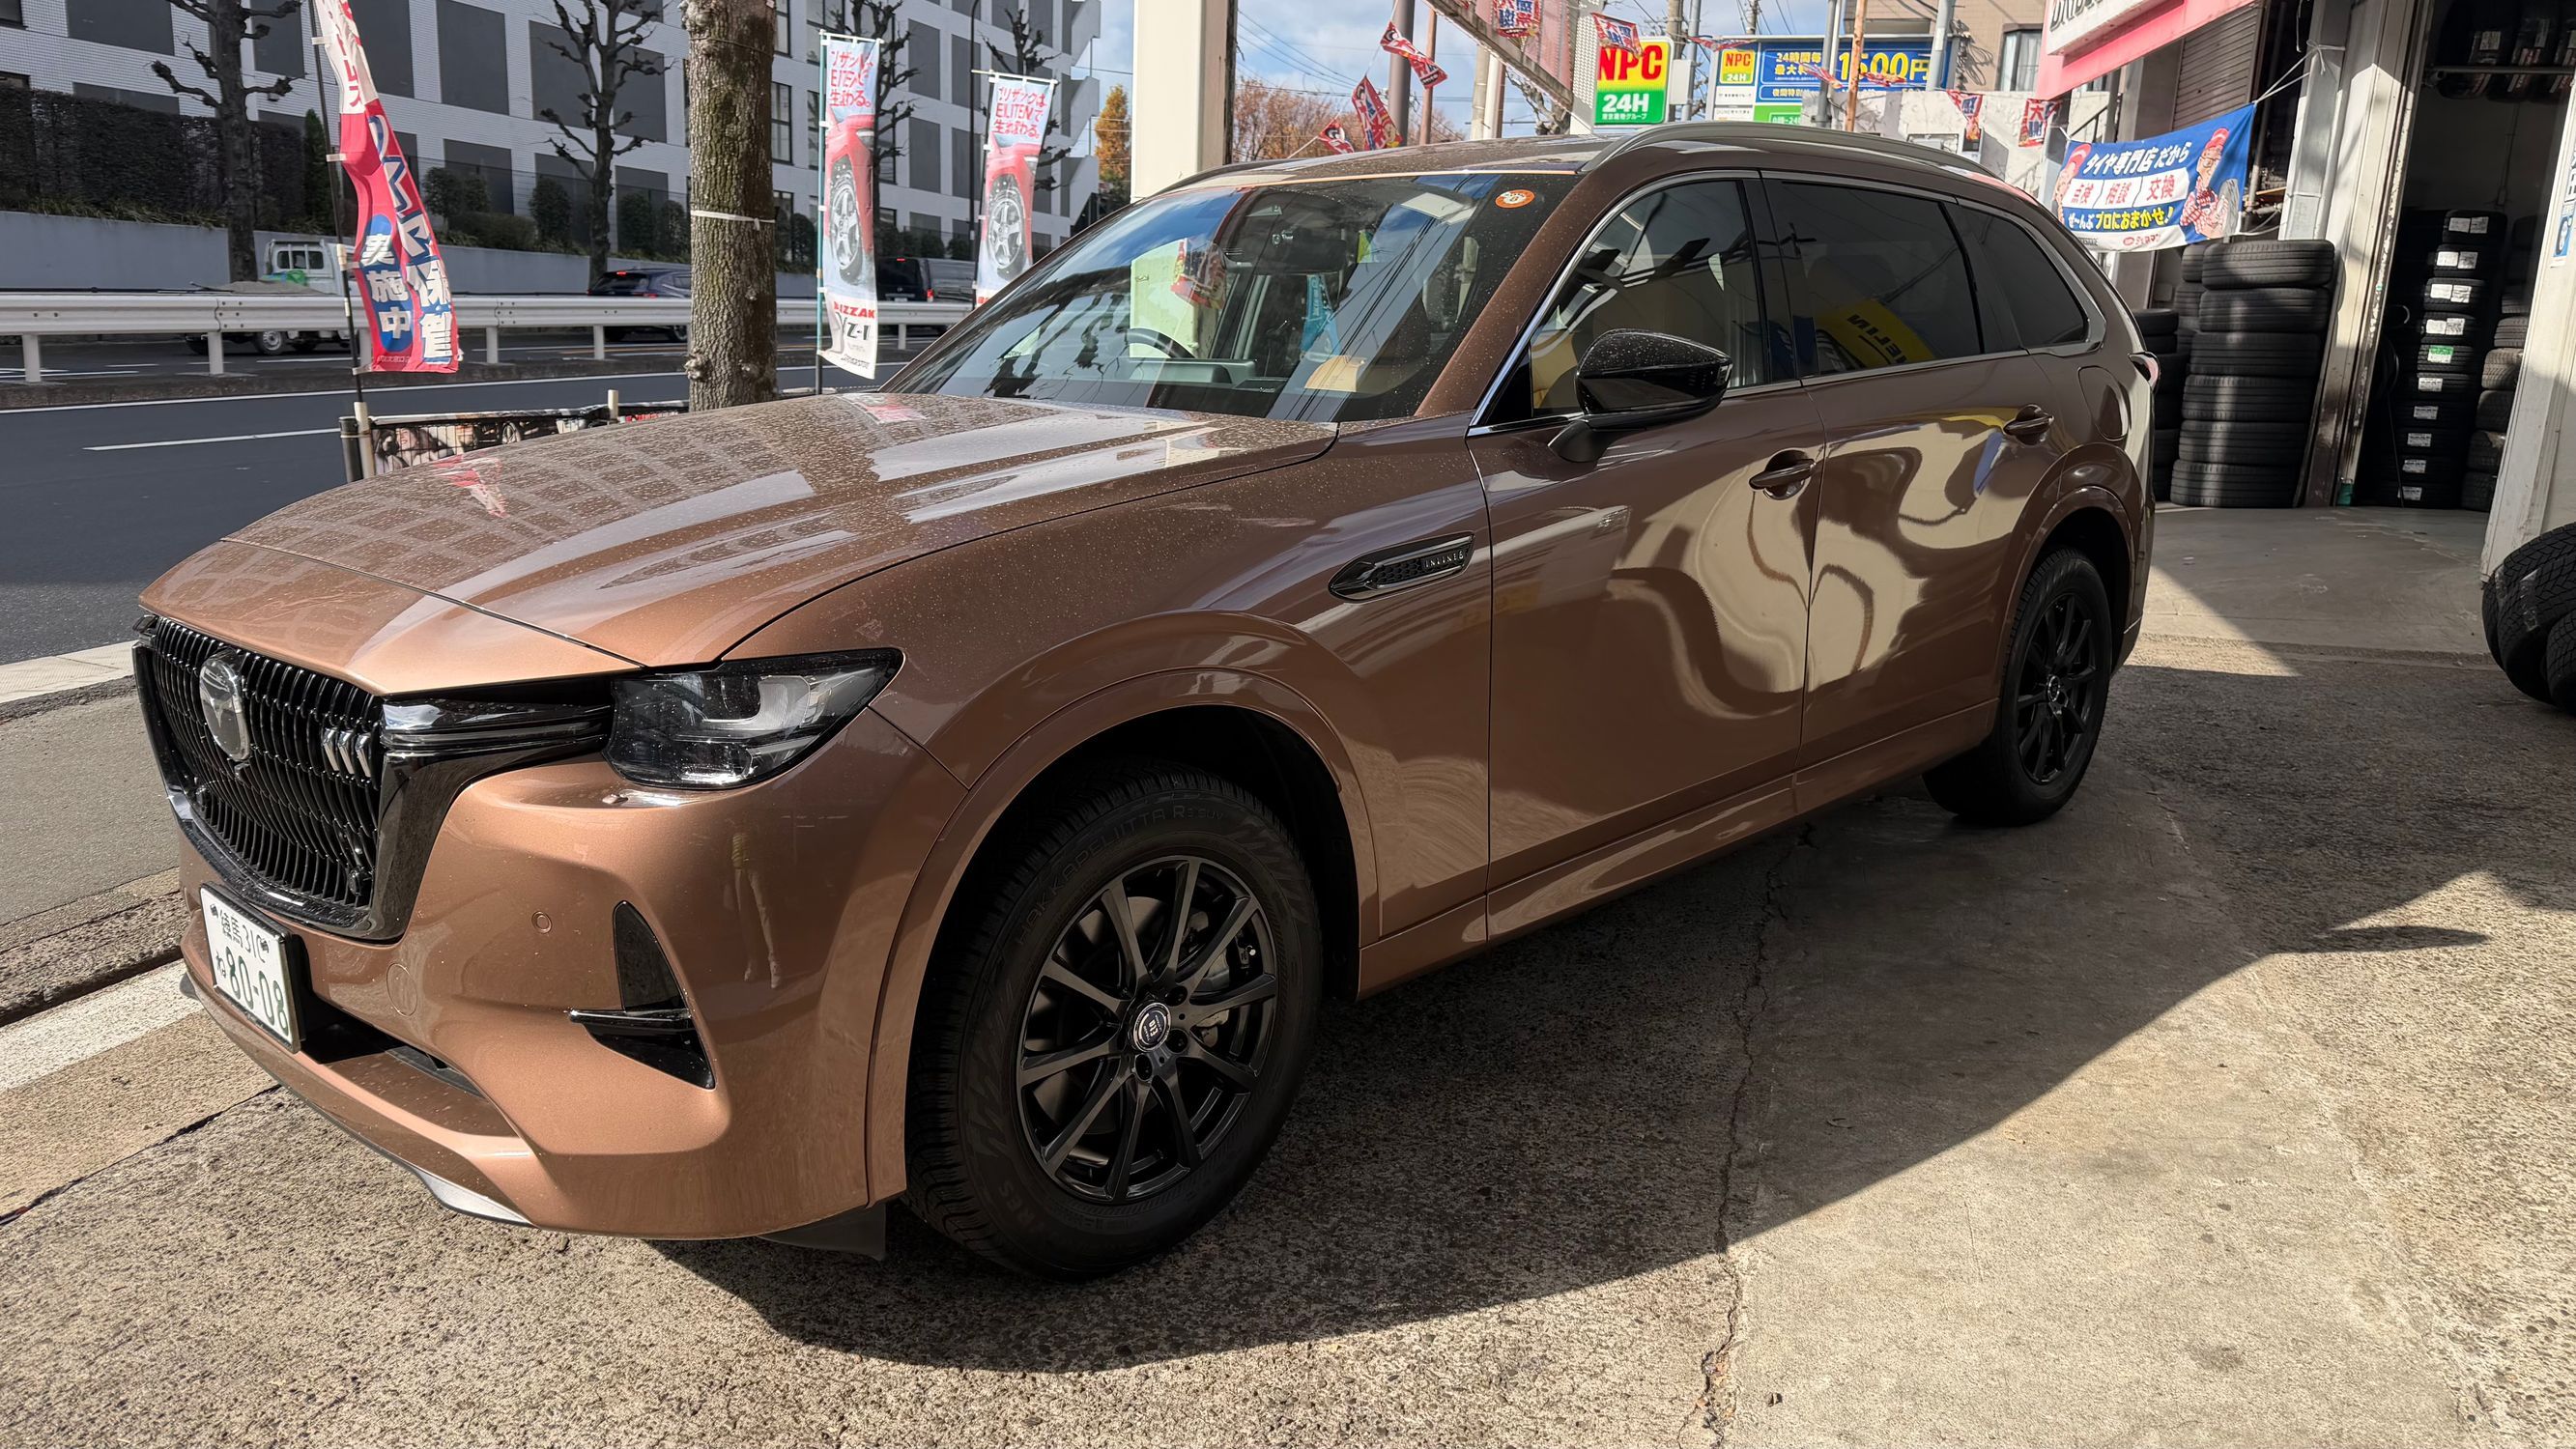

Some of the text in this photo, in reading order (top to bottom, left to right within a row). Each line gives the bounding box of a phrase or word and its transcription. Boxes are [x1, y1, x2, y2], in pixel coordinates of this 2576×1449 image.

[1597, 45, 1662, 80] NPC
[1725, 53, 1751, 67] NPC
[1602, 93, 1649, 113] 24H
[2083, 142, 2192, 175] タイヤ専門店だから
[2146, 175, 2175, 201] 交換
[360, 234, 412, 340] 実施中
[225, 946, 289, 1037] 80-08
